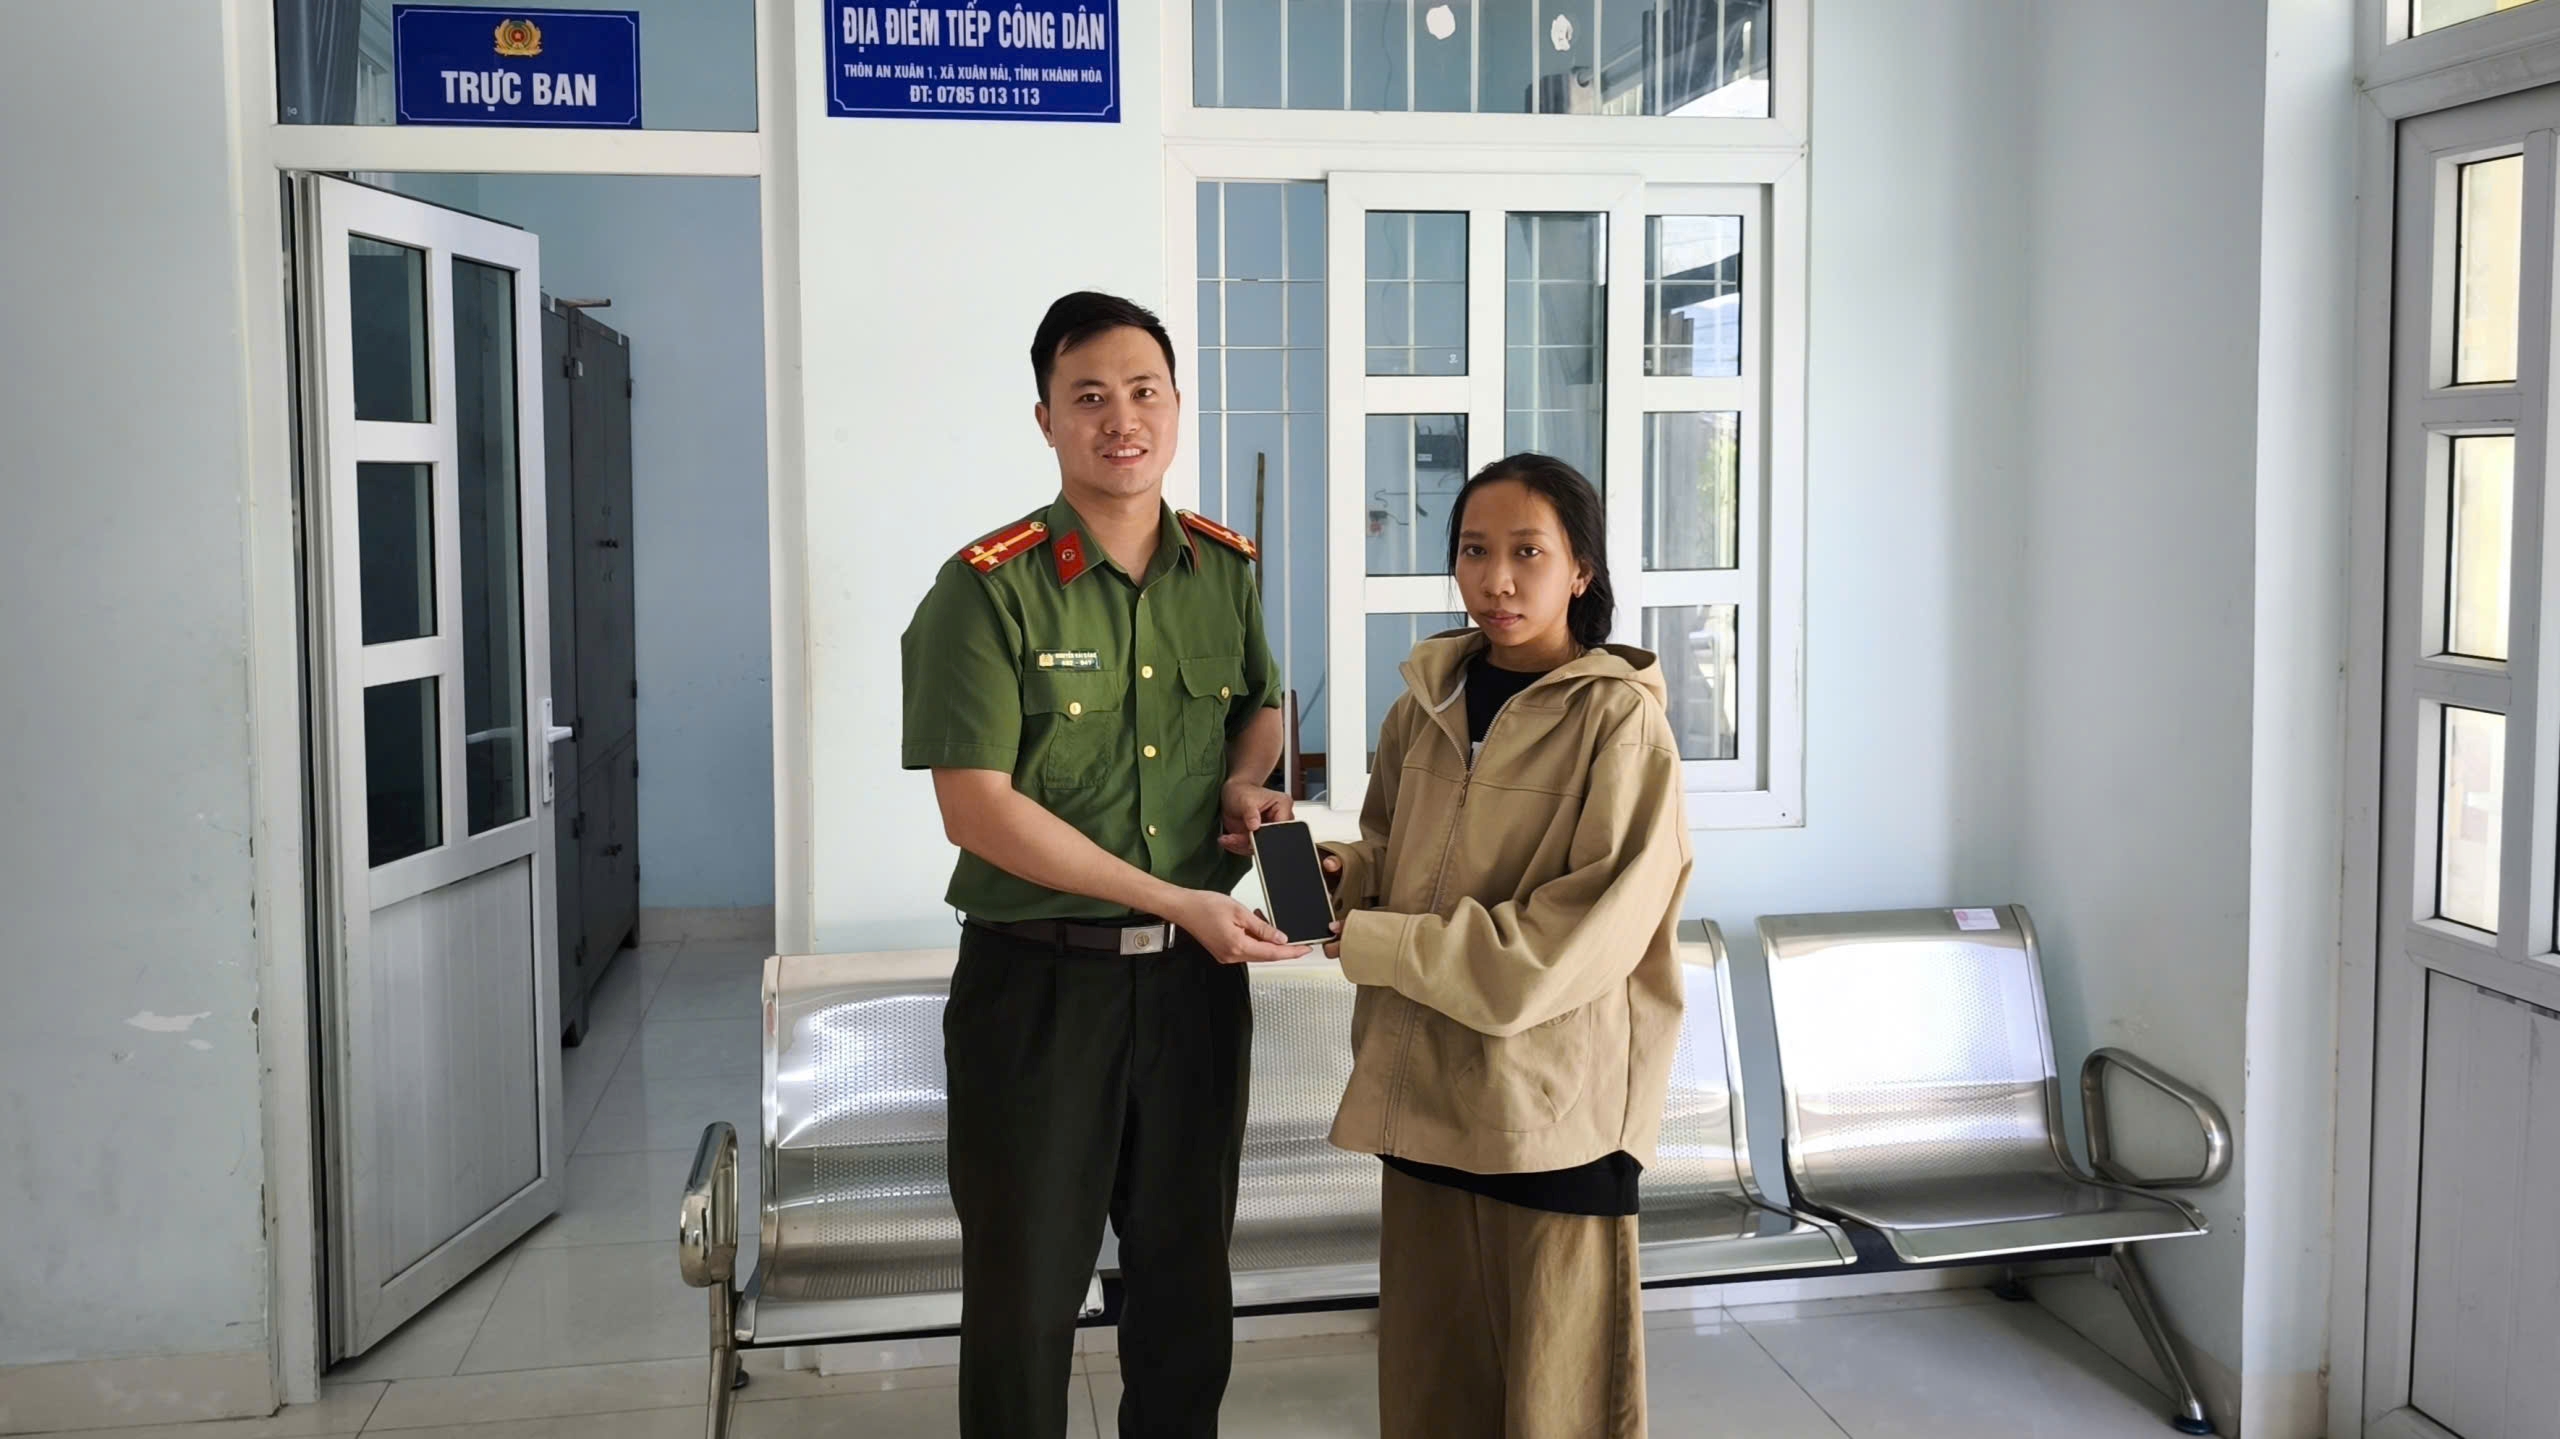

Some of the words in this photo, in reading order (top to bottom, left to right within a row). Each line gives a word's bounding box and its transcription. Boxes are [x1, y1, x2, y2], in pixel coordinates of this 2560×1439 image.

[843, 7, 880, 53] ĐỊA
[885, 0, 940, 46] ĐIỂM
[945, 0, 991, 47] TIẾP
[998, 3, 1056, 49] CÔNG
[1062, 4, 1105, 50] DÂN
[844, 61, 873, 78] THÔN
[875, 64, 891, 78] AN
[894, 62, 925, 79] XUÂN
[940, 64, 955, 80] XÃ
[958, 64, 987, 80] XUÂN
[1041, 66, 1078, 83] KHÁNH
[1081, 66, 1103, 83] HÒA
[440, 69, 522, 111] TRỰC
[532, 73, 597, 107] BAN
[909, 84, 933, 103] ĐT:
[936, 85, 975, 104] 0785
[978, 86, 1008, 105] 013
[1012, 87, 1040, 105] 113
